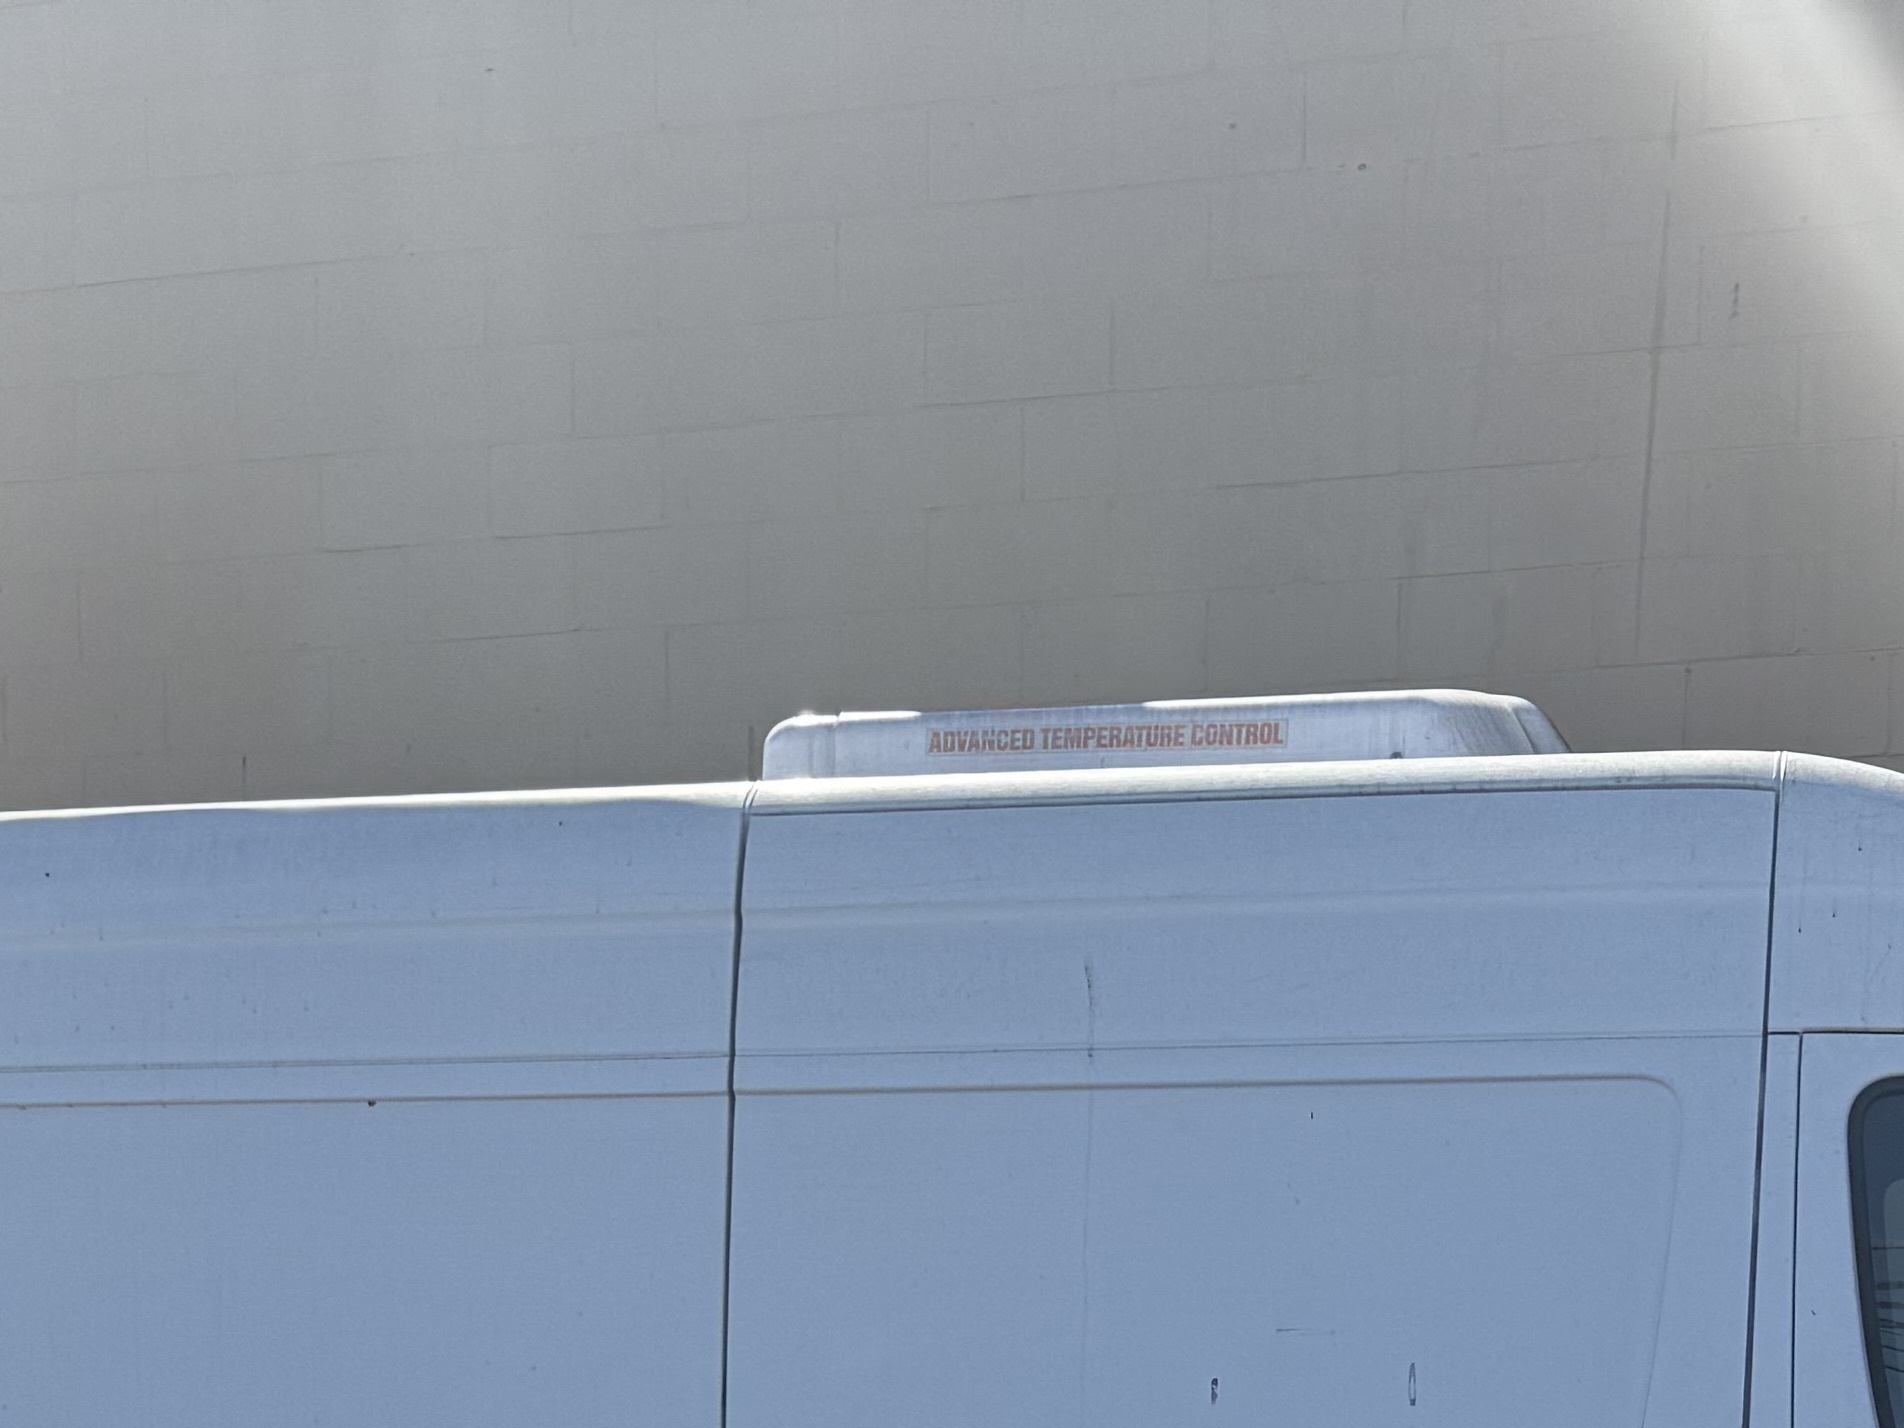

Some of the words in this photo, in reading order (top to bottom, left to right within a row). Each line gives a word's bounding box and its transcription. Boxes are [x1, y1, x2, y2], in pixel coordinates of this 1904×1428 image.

[929, 727, 1035, 753] ADVANCED
[1040, 724, 1185, 750] TEMPERATURE
[1191, 721, 1284, 747] CONTROL
